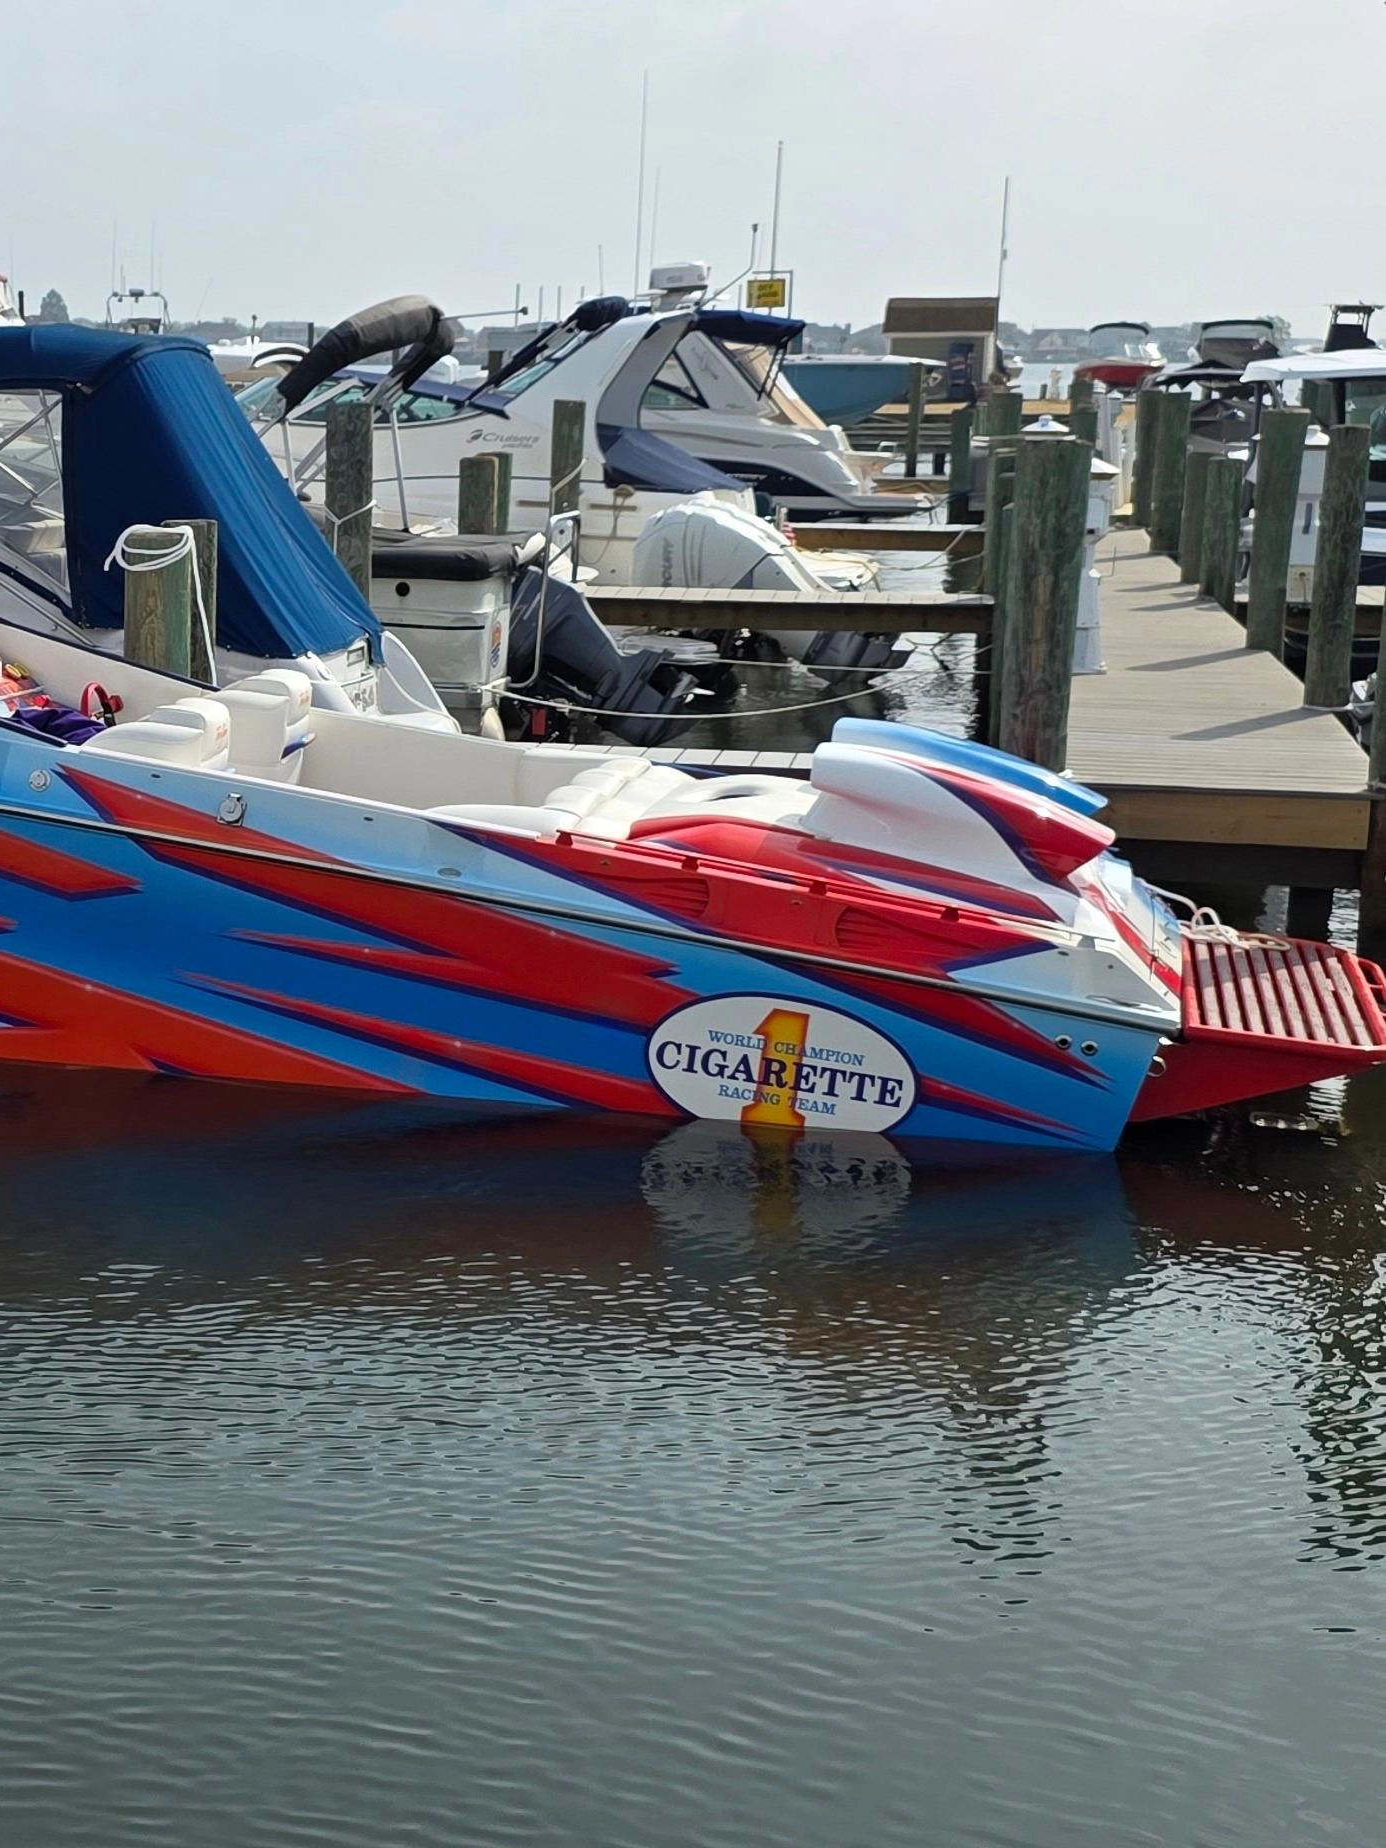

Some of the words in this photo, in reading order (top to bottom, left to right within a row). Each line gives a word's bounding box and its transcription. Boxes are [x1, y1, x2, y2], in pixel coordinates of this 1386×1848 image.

[708, 1029, 766, 1050] WORLD
[773, 1040, 864, 1067] CHAMPION
[655, 1040, 903, 1108] CIGARETTE
[718, 1084, 781, 1106] RACING
[787, 1096, 836, 1116] TEAM
